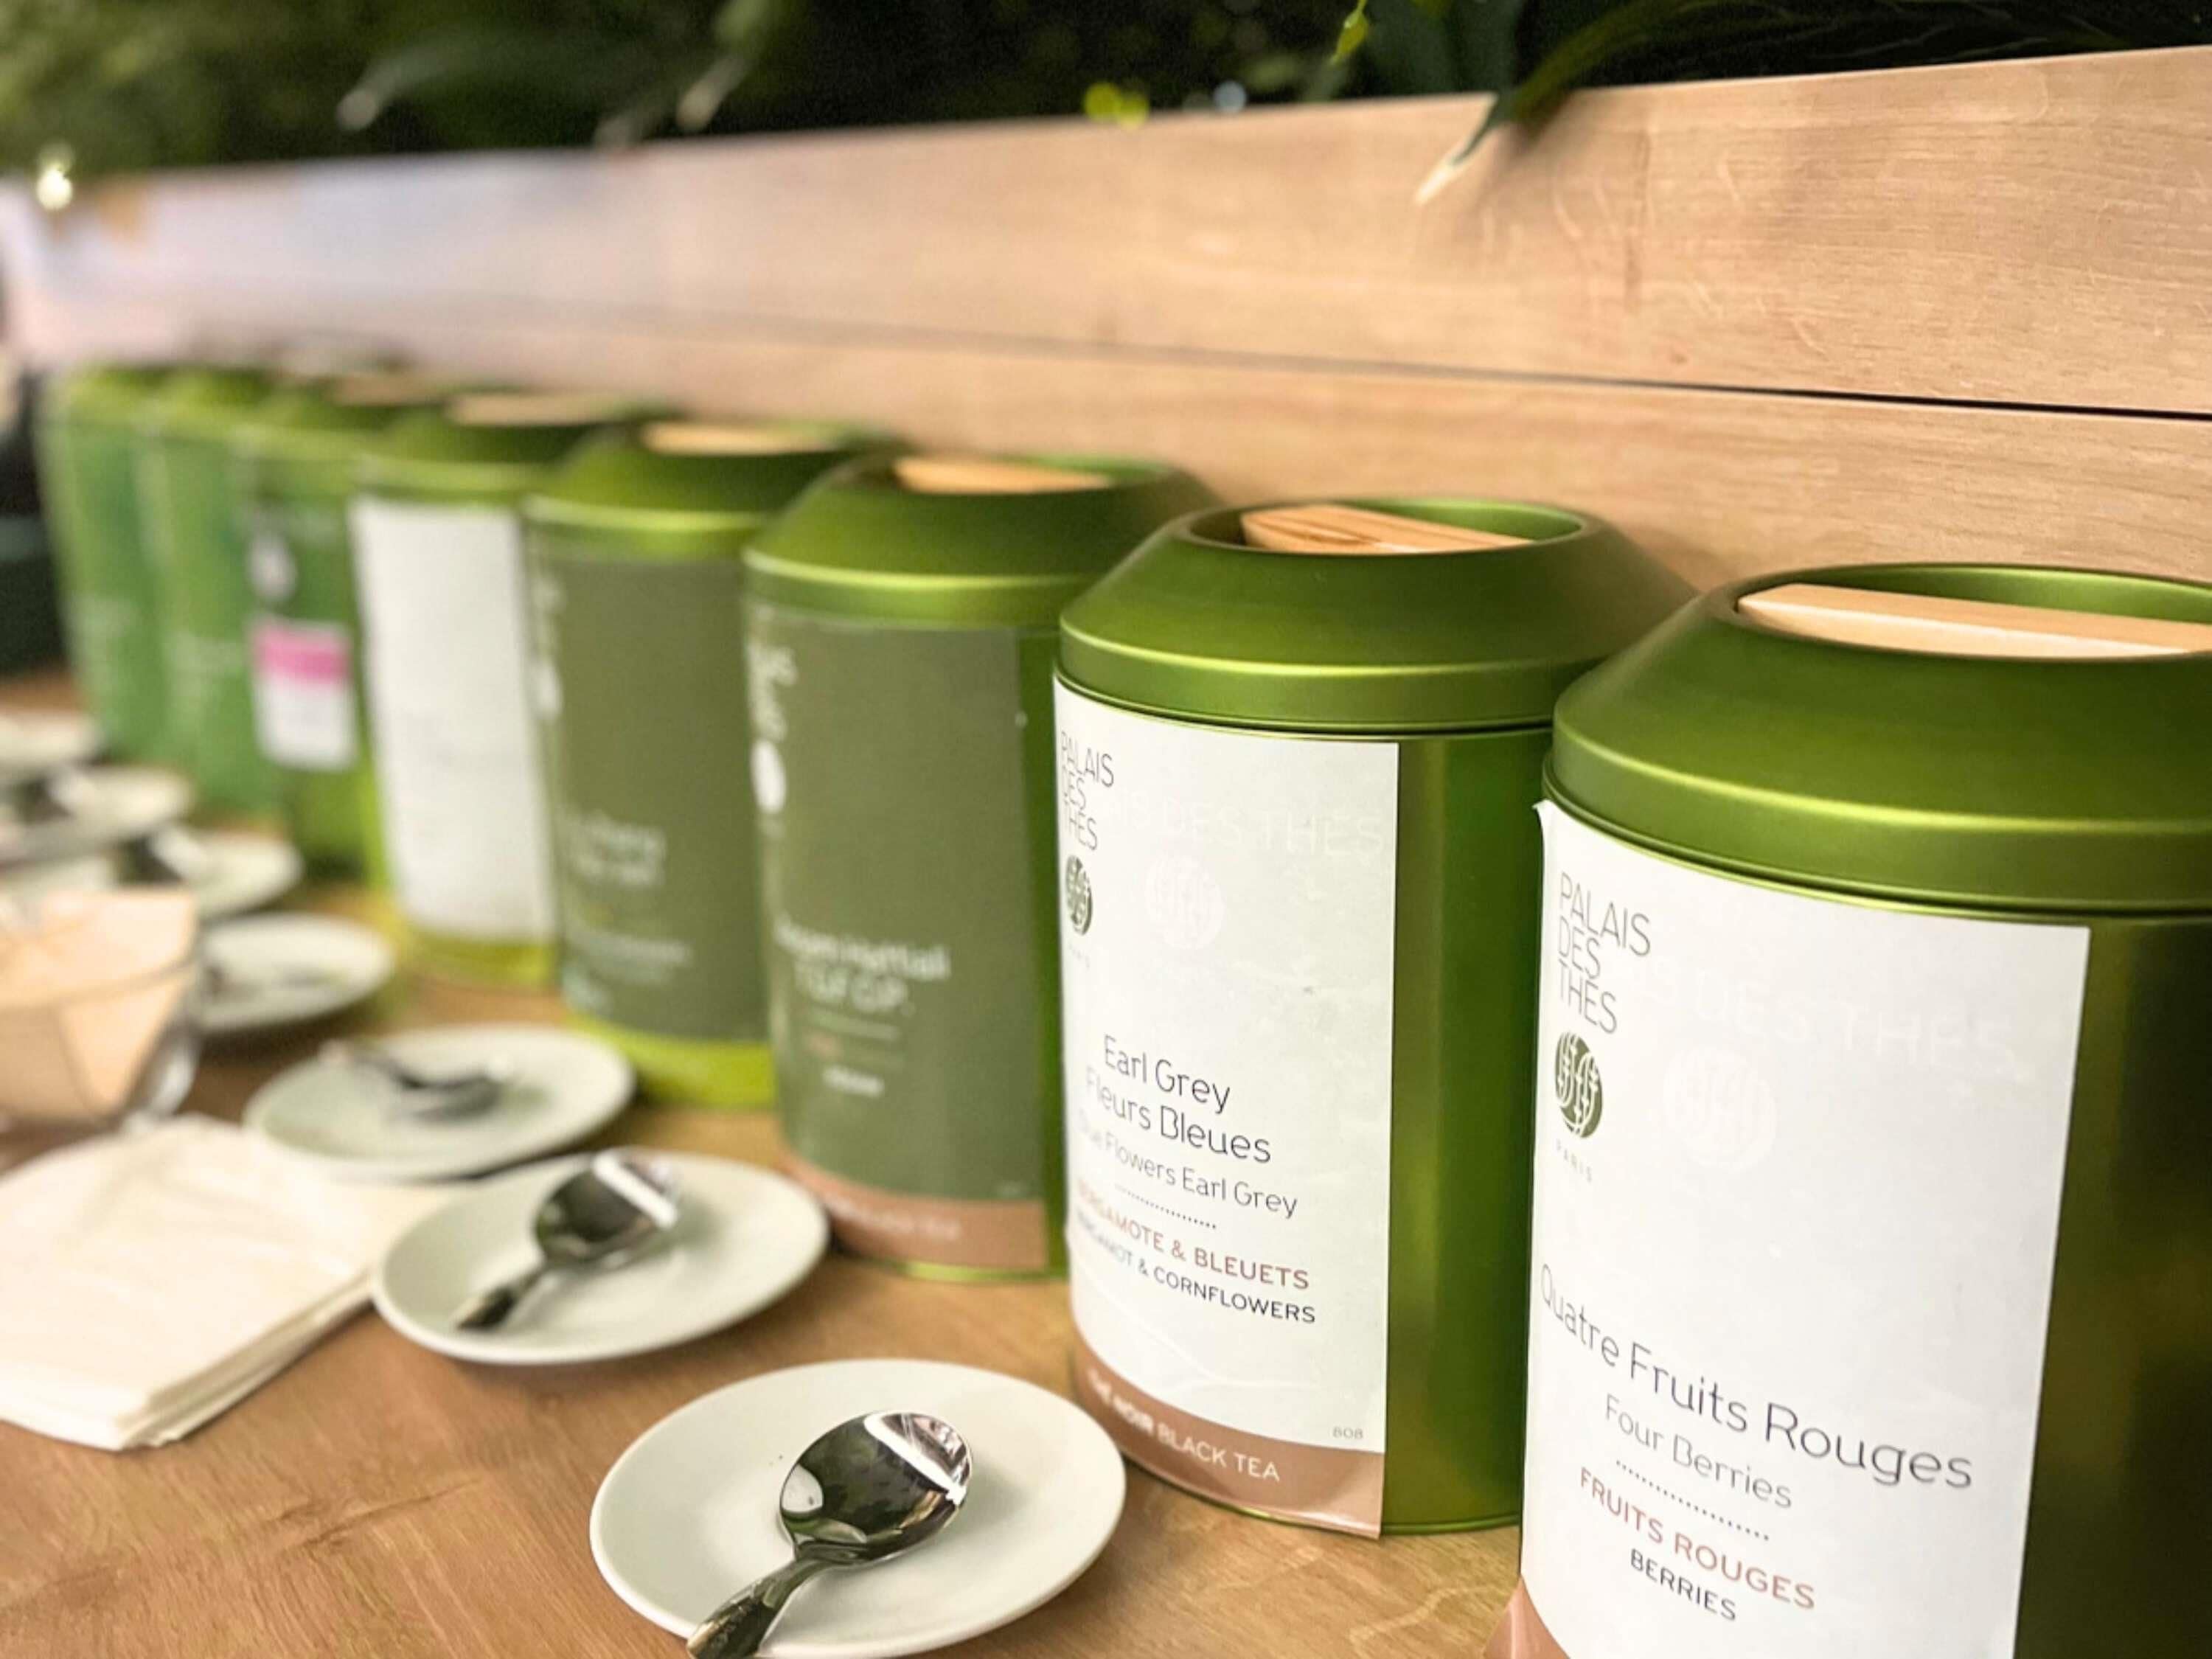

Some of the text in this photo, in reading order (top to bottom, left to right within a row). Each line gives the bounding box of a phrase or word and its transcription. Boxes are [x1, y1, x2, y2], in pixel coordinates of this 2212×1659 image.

[1558, 914, 1601, 981] DES
[1559, 871, 1651, 957] PALAIS
[1085, 1065, 1151, 1130] Fleurs
[1160, 1105, 1271, 1164] Bleues
[1103, 1033, 1231, 1115] Earl Grey
[1105, 1130, 1298, 1220] Flowers Earl Grey
[1153, 1265, 1316, 1324] CORNFLOWERS
[1171, 1239, 1186, 1262] &
[1194, 1248, 1310, 1290] BLEUETS
[1540, 1263, 1973, 1489] Quatre Fruits Rouges
[1157, 1422, 1228, 1468] BLACK
[1233, 1450, 1281, 1482] TEA
[1605, 1393, 1792, 1510] Four Berries
[1580, 1466, 1815, 1610] FRUITS ROUGES
[1630, 1548, 1738, 1621] BERRIES
